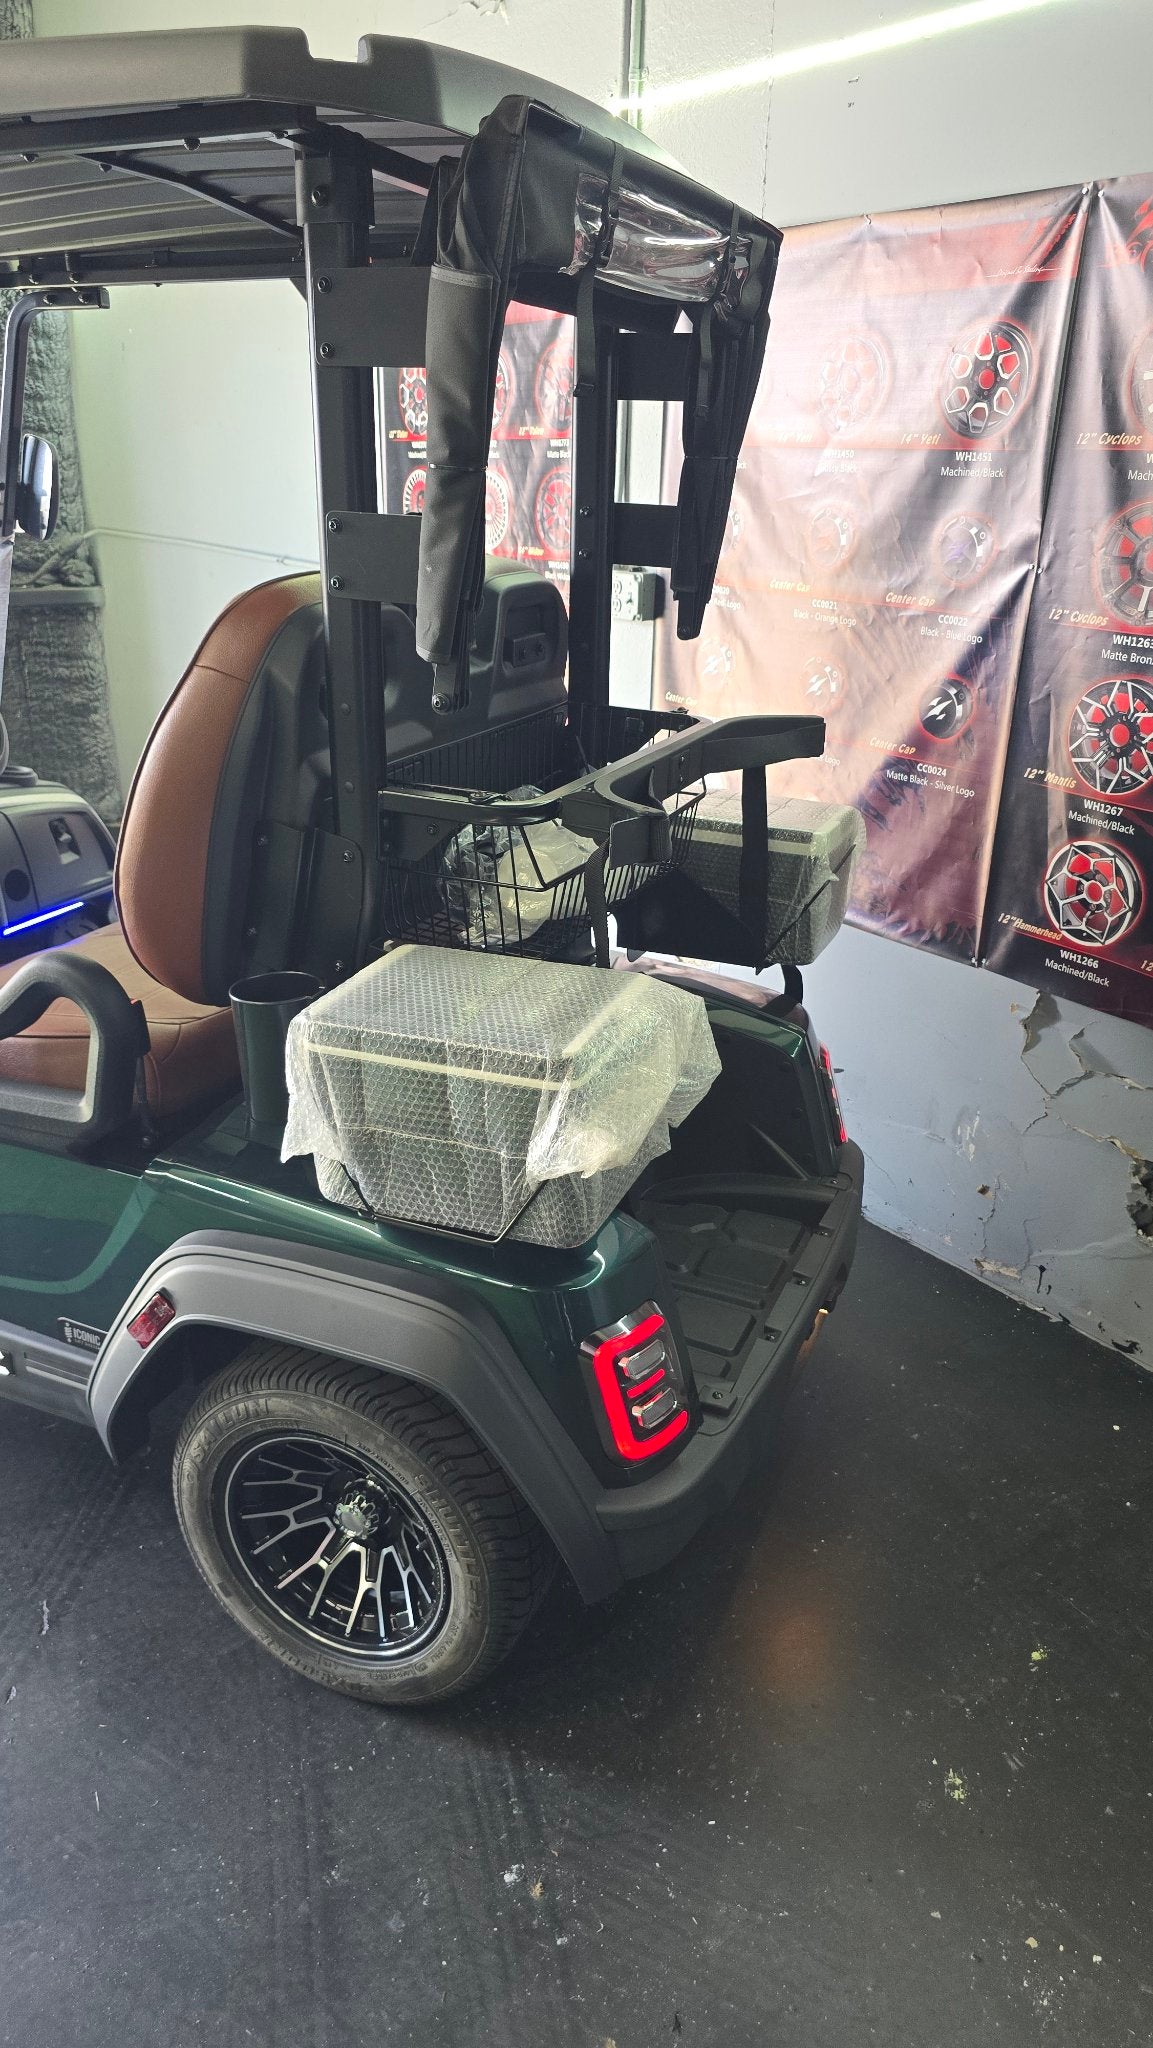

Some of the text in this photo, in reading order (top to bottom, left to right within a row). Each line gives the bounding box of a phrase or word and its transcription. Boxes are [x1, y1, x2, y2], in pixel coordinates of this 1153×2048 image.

[920, 433, 942, 445] Yeti
[1076, 432, 1143, 445] 12" Cyclops
[955, 451, 993, 462] WH1451
[940, 466, 1004, 478] Machined/Black
[885, 591, 936, 607] Center Cap
[815, 610, 839, 624] Orange
[839, 614, 857, 627] Logo
[938, 614, 968, 627] CC0022
[1048, 608, 1109, 626] 12" Cyclops
[920, 626, 939, 637] Black
[946, 629, 962, 641] Blue
[962, 632, 983, 645] Logo
[1101, 648, 1153, 665] Matte Bron
[869, 737, 916, 755] Center Cap
[916, 762, 947, 777] CC0024
[1023, 767, 1077, 789] 12" Mantis
[886, 769, 908, 782] Matte
[909, 774, 929, 787] Black
[934, 780, 955, 792] Silver
[955, 784, 975, 798] Logo
[1083, 798, 1124, 817] WH1267
[1068, 810, 1135, 836] Machined/Black
[1059, 949, 1099, 969] WH1266
[1044, 958, 1110, 987] Machined/Black
[73, 1327, 101, 1346] ICONIC
[188, 1398, 270, 1463] SAILUN
